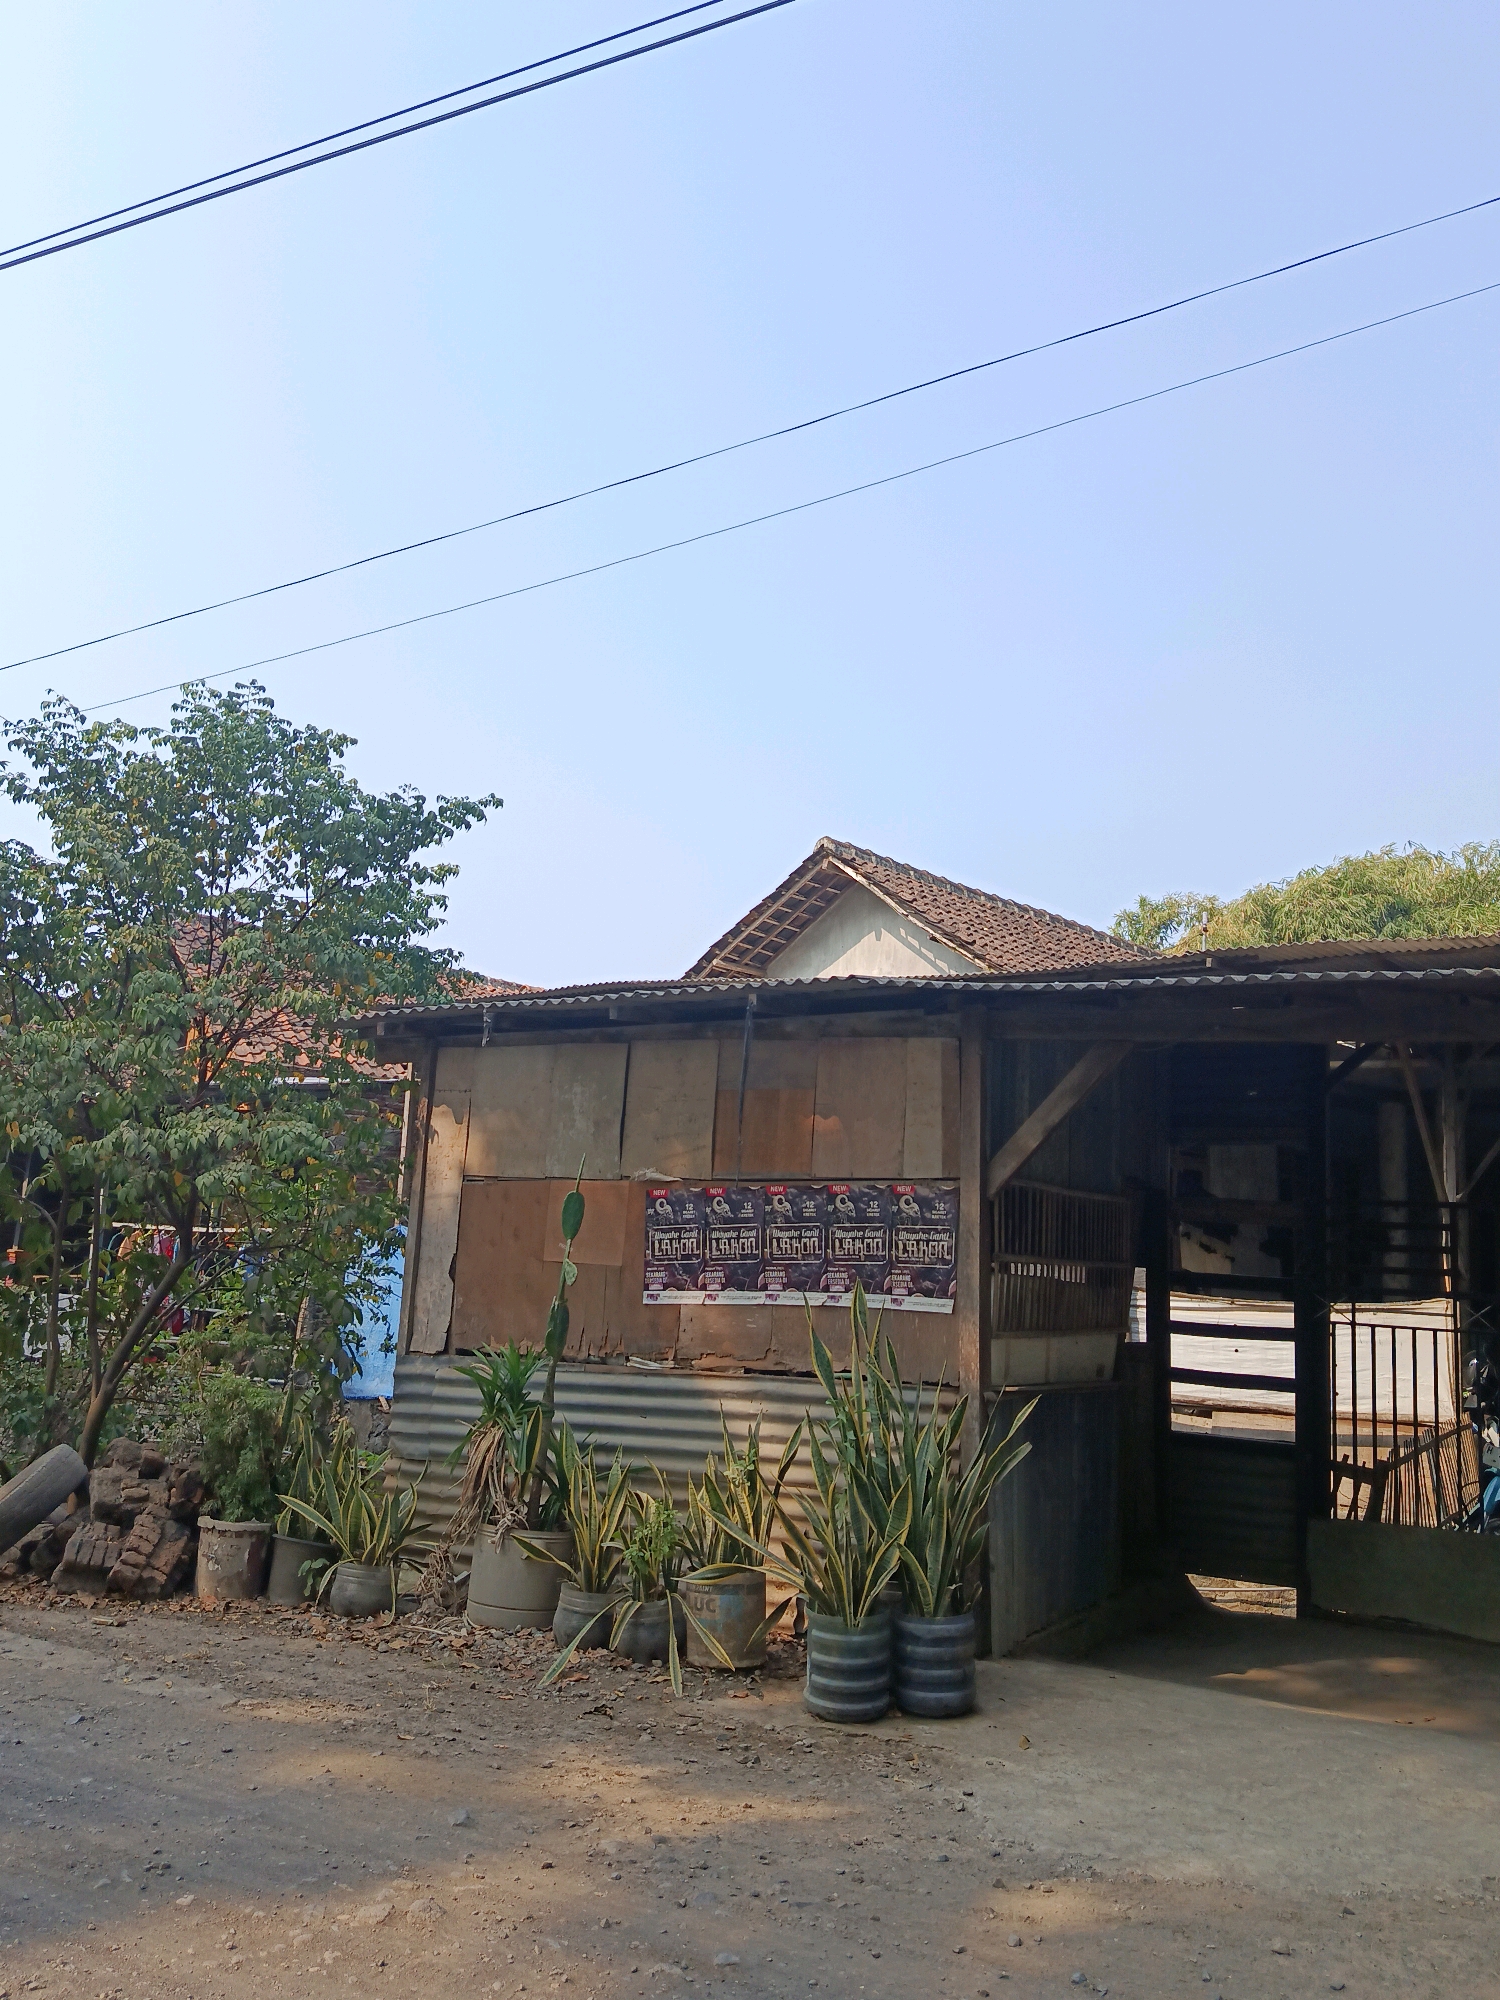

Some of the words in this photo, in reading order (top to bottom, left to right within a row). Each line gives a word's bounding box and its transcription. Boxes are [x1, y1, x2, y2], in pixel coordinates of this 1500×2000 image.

[655, 1239, 699, 1260] LAKON
[712, 1238, 758, 1259] LAKON
[772, 1238, 821, 1259] LAKON
[835, 1239, 885, 1261] LAKON
[899, 1241, 951, 1263] LAKON
